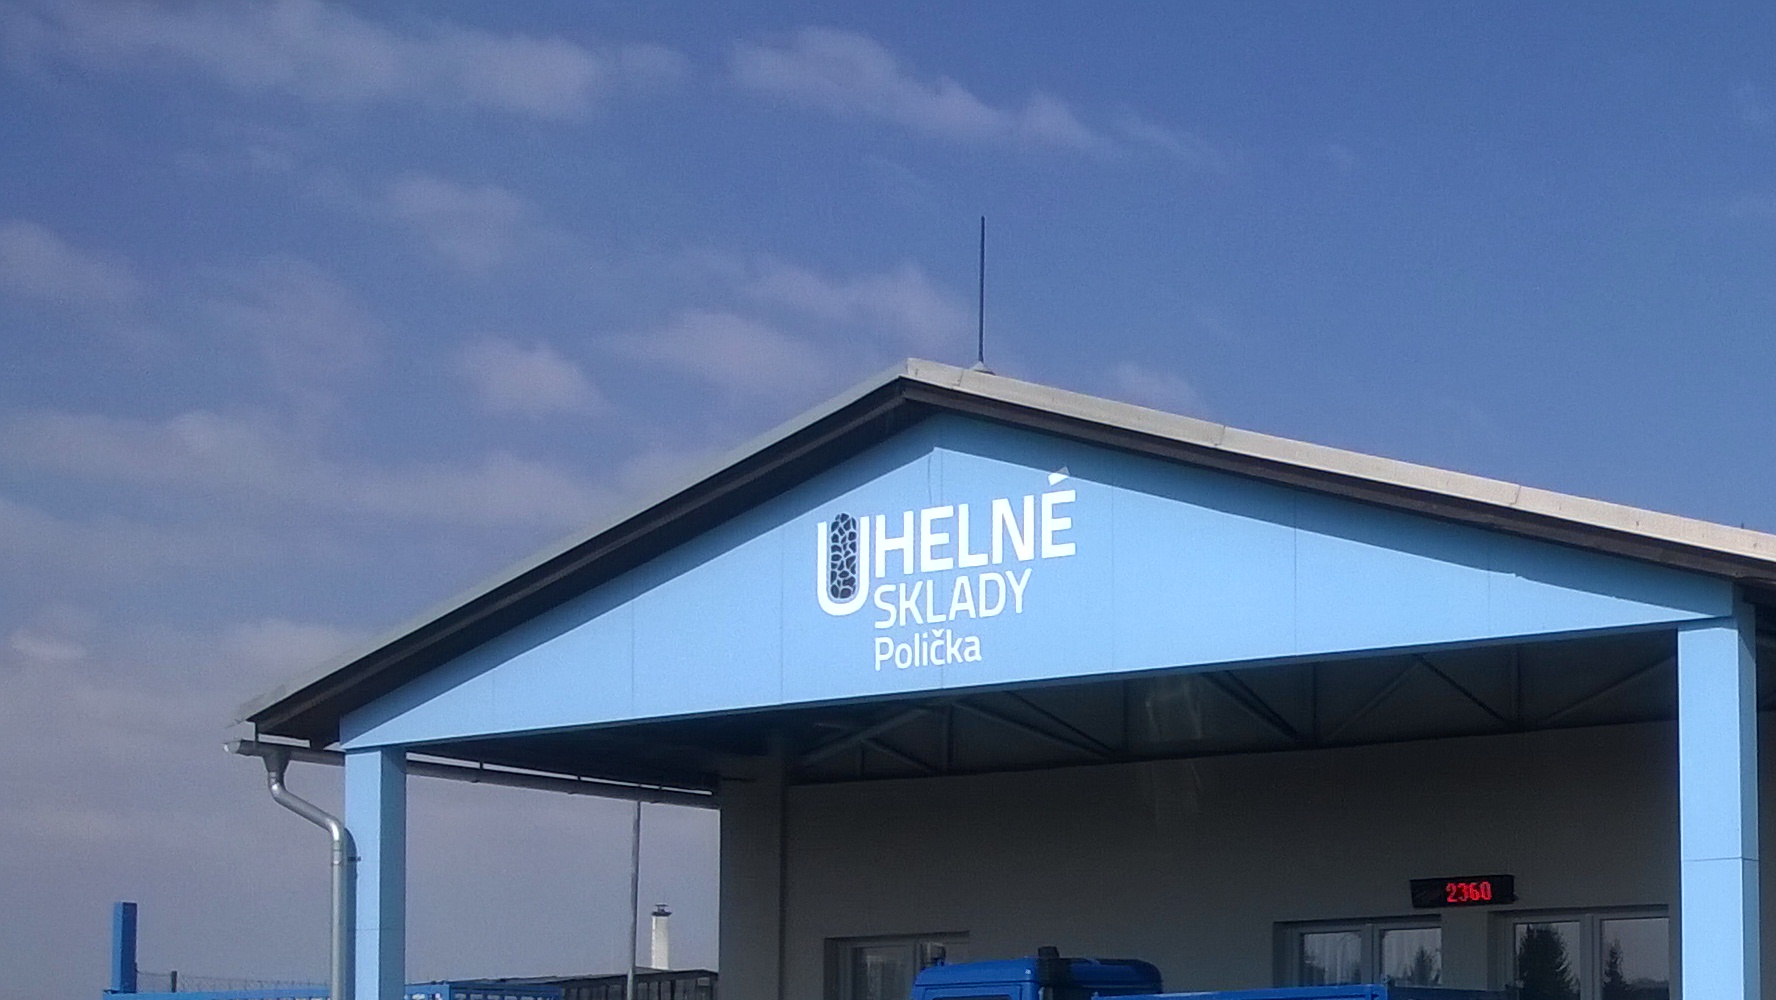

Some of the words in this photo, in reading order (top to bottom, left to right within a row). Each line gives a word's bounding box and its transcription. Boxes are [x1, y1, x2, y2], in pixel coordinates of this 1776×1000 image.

[817, 466, 1076, 616] UHELNÉ
[874, 568, 1032, 629] SKLADY
[874, 628, 982, 671] Polička
[1446, 881, 1492, 903] 2360
